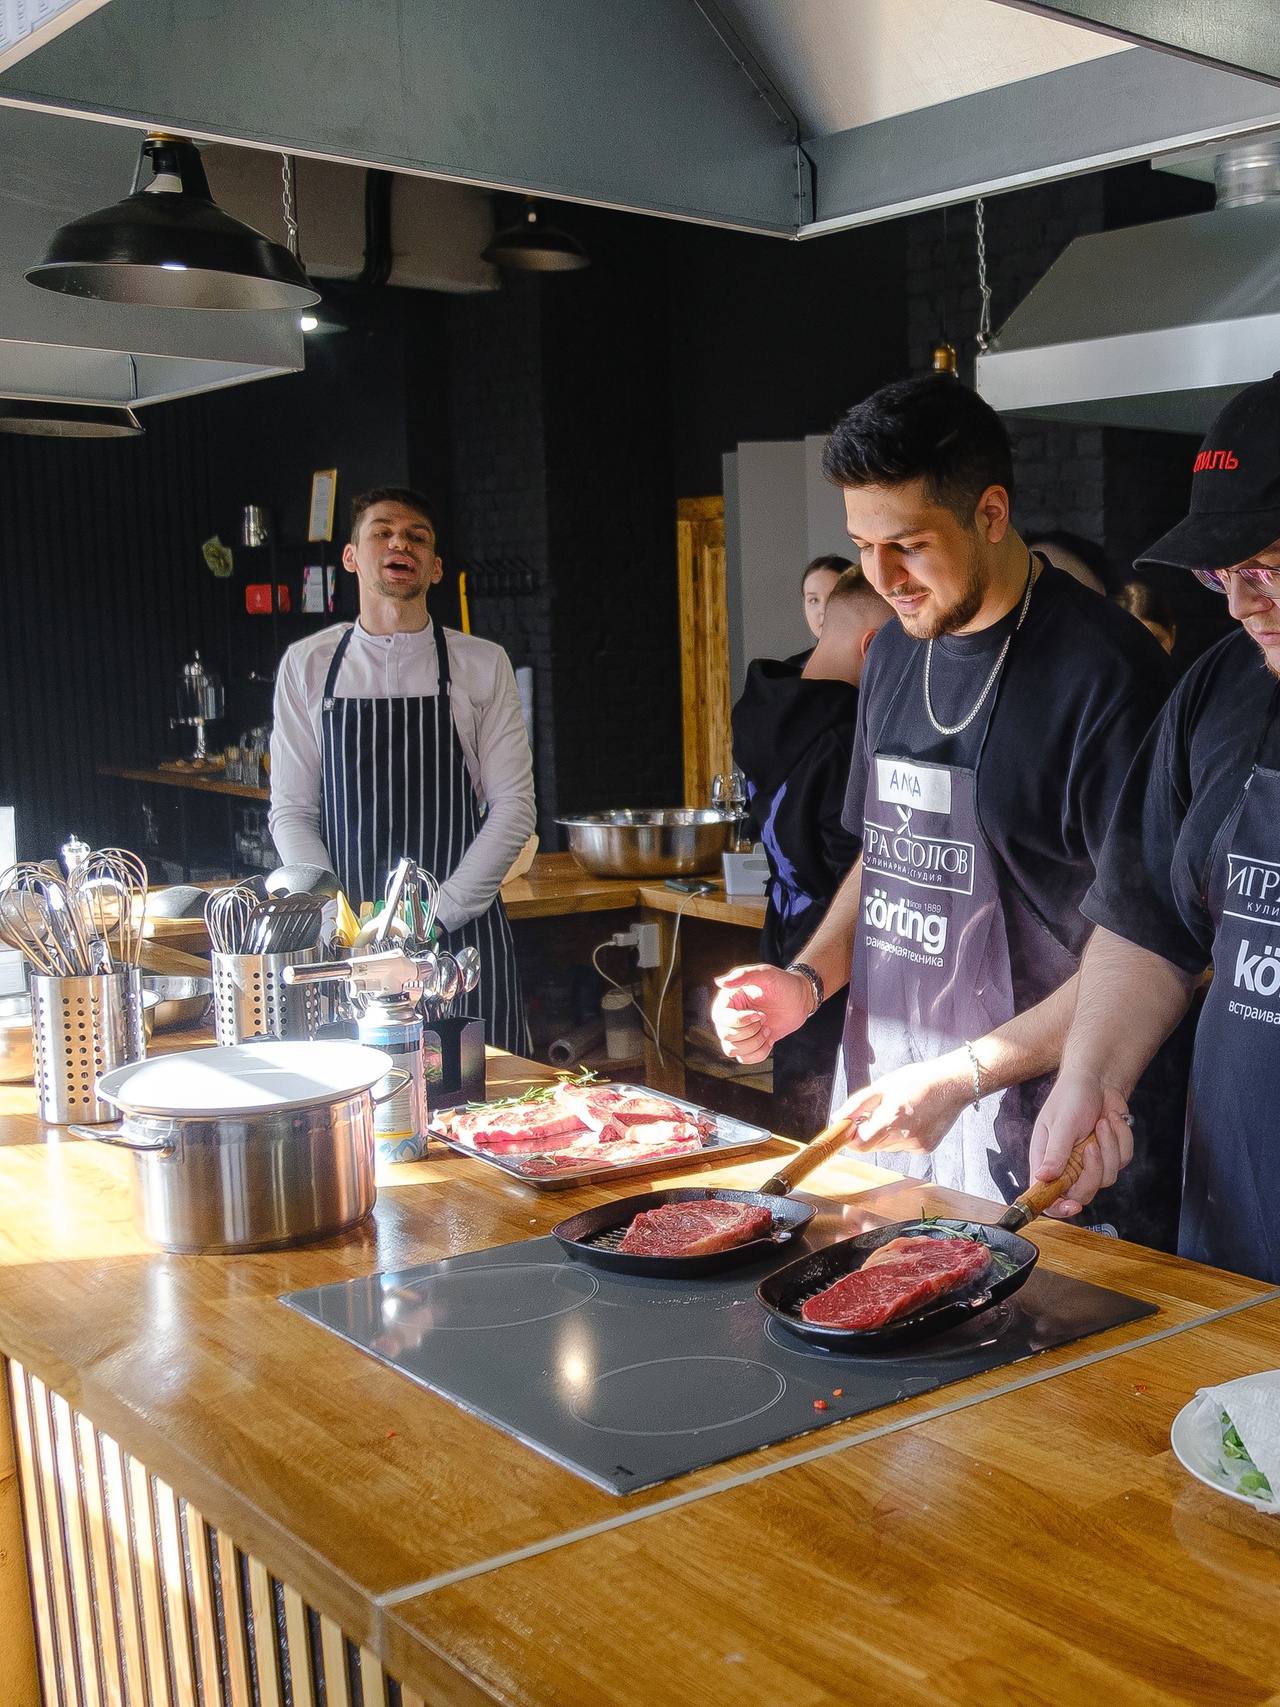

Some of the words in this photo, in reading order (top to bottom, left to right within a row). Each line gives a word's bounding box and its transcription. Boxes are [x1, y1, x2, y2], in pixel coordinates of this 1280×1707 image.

[866, 855, 909, 875] УЛИНАРНА
[894, 837, 968, 875] СТОЛОВ
[909, 900, 922, 910] ince
[924, 903, 942, 914] 1889
[866, 935, 907, 958] раиваемая
[907, 949, 944, 967] техника
